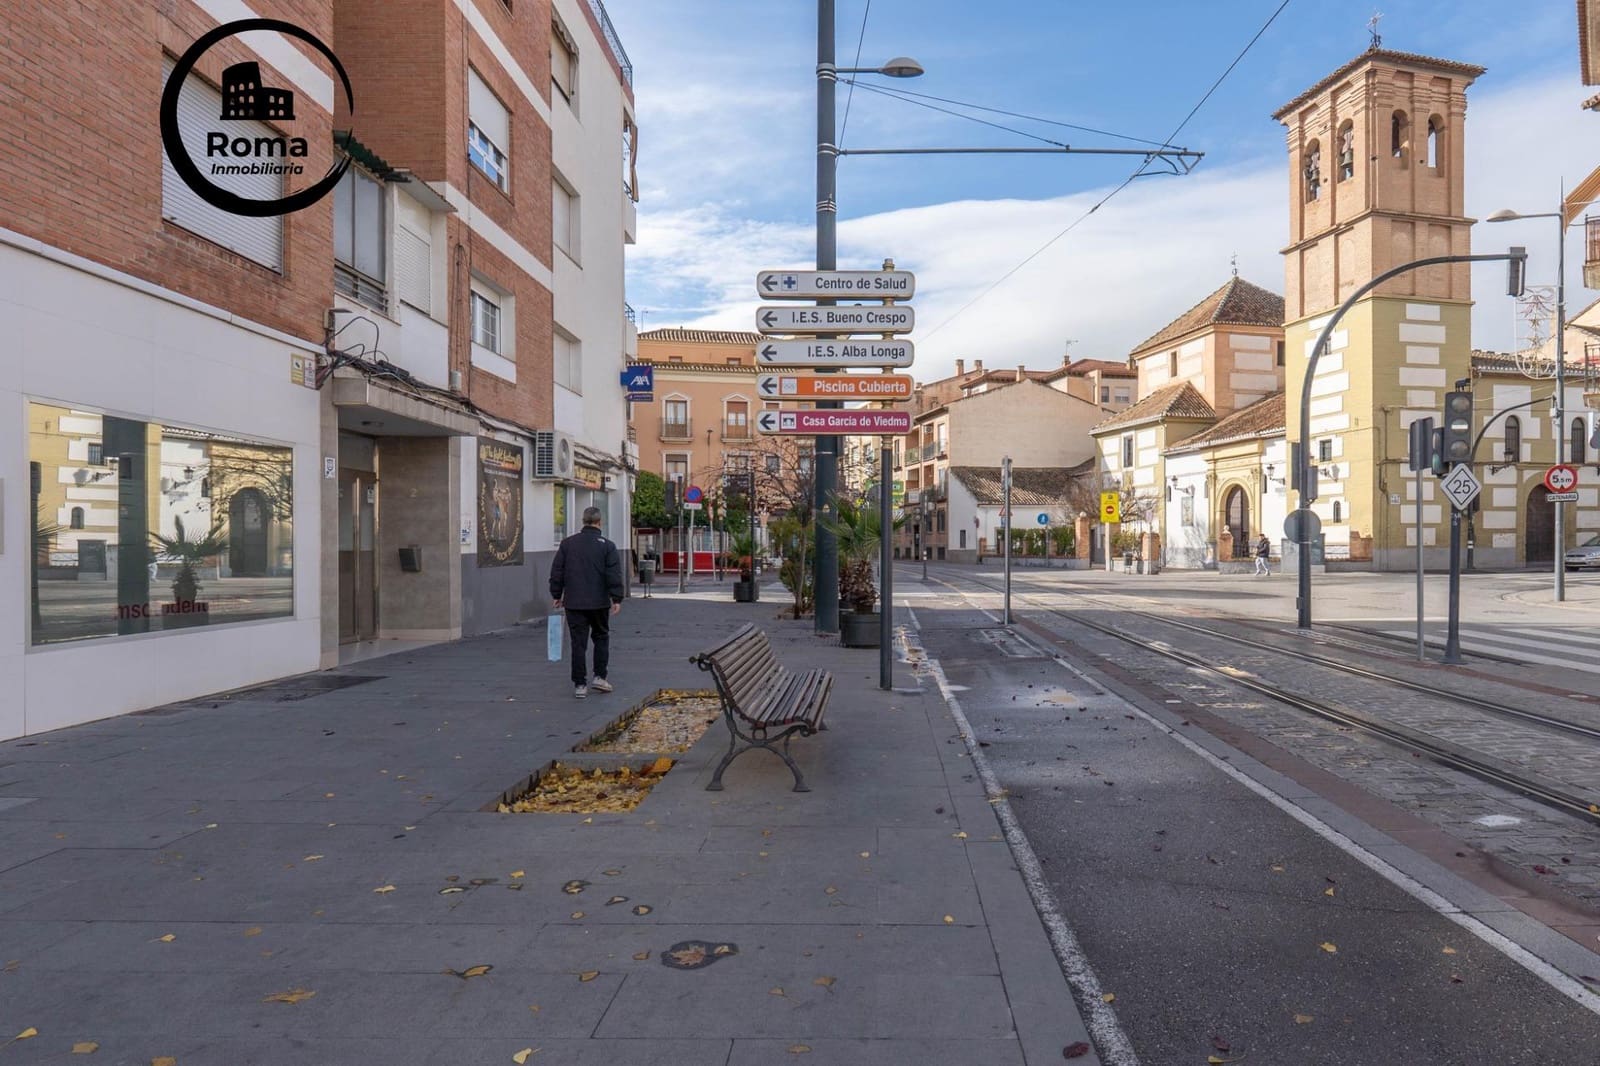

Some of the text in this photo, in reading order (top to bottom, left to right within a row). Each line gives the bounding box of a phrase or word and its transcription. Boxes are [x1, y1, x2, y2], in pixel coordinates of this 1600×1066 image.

[815, 277, 907, 290] Centro de Salud
[792, 311, 907, 326] I.E.S. Bueno Crespo
[807, 345, 905, 360] I.E.S. Alba Longa
[630, 375, 651, 386] AXA
[814, 380, 906, 393] Piscina Cubierta
[802, 416, 825, 427] Casa
[859, 416, 871, 427] de
[873, 416, 908, 427] Viedma
[409, 487, 418, 498] 2
[1453, 479, 1471, 494] 25
